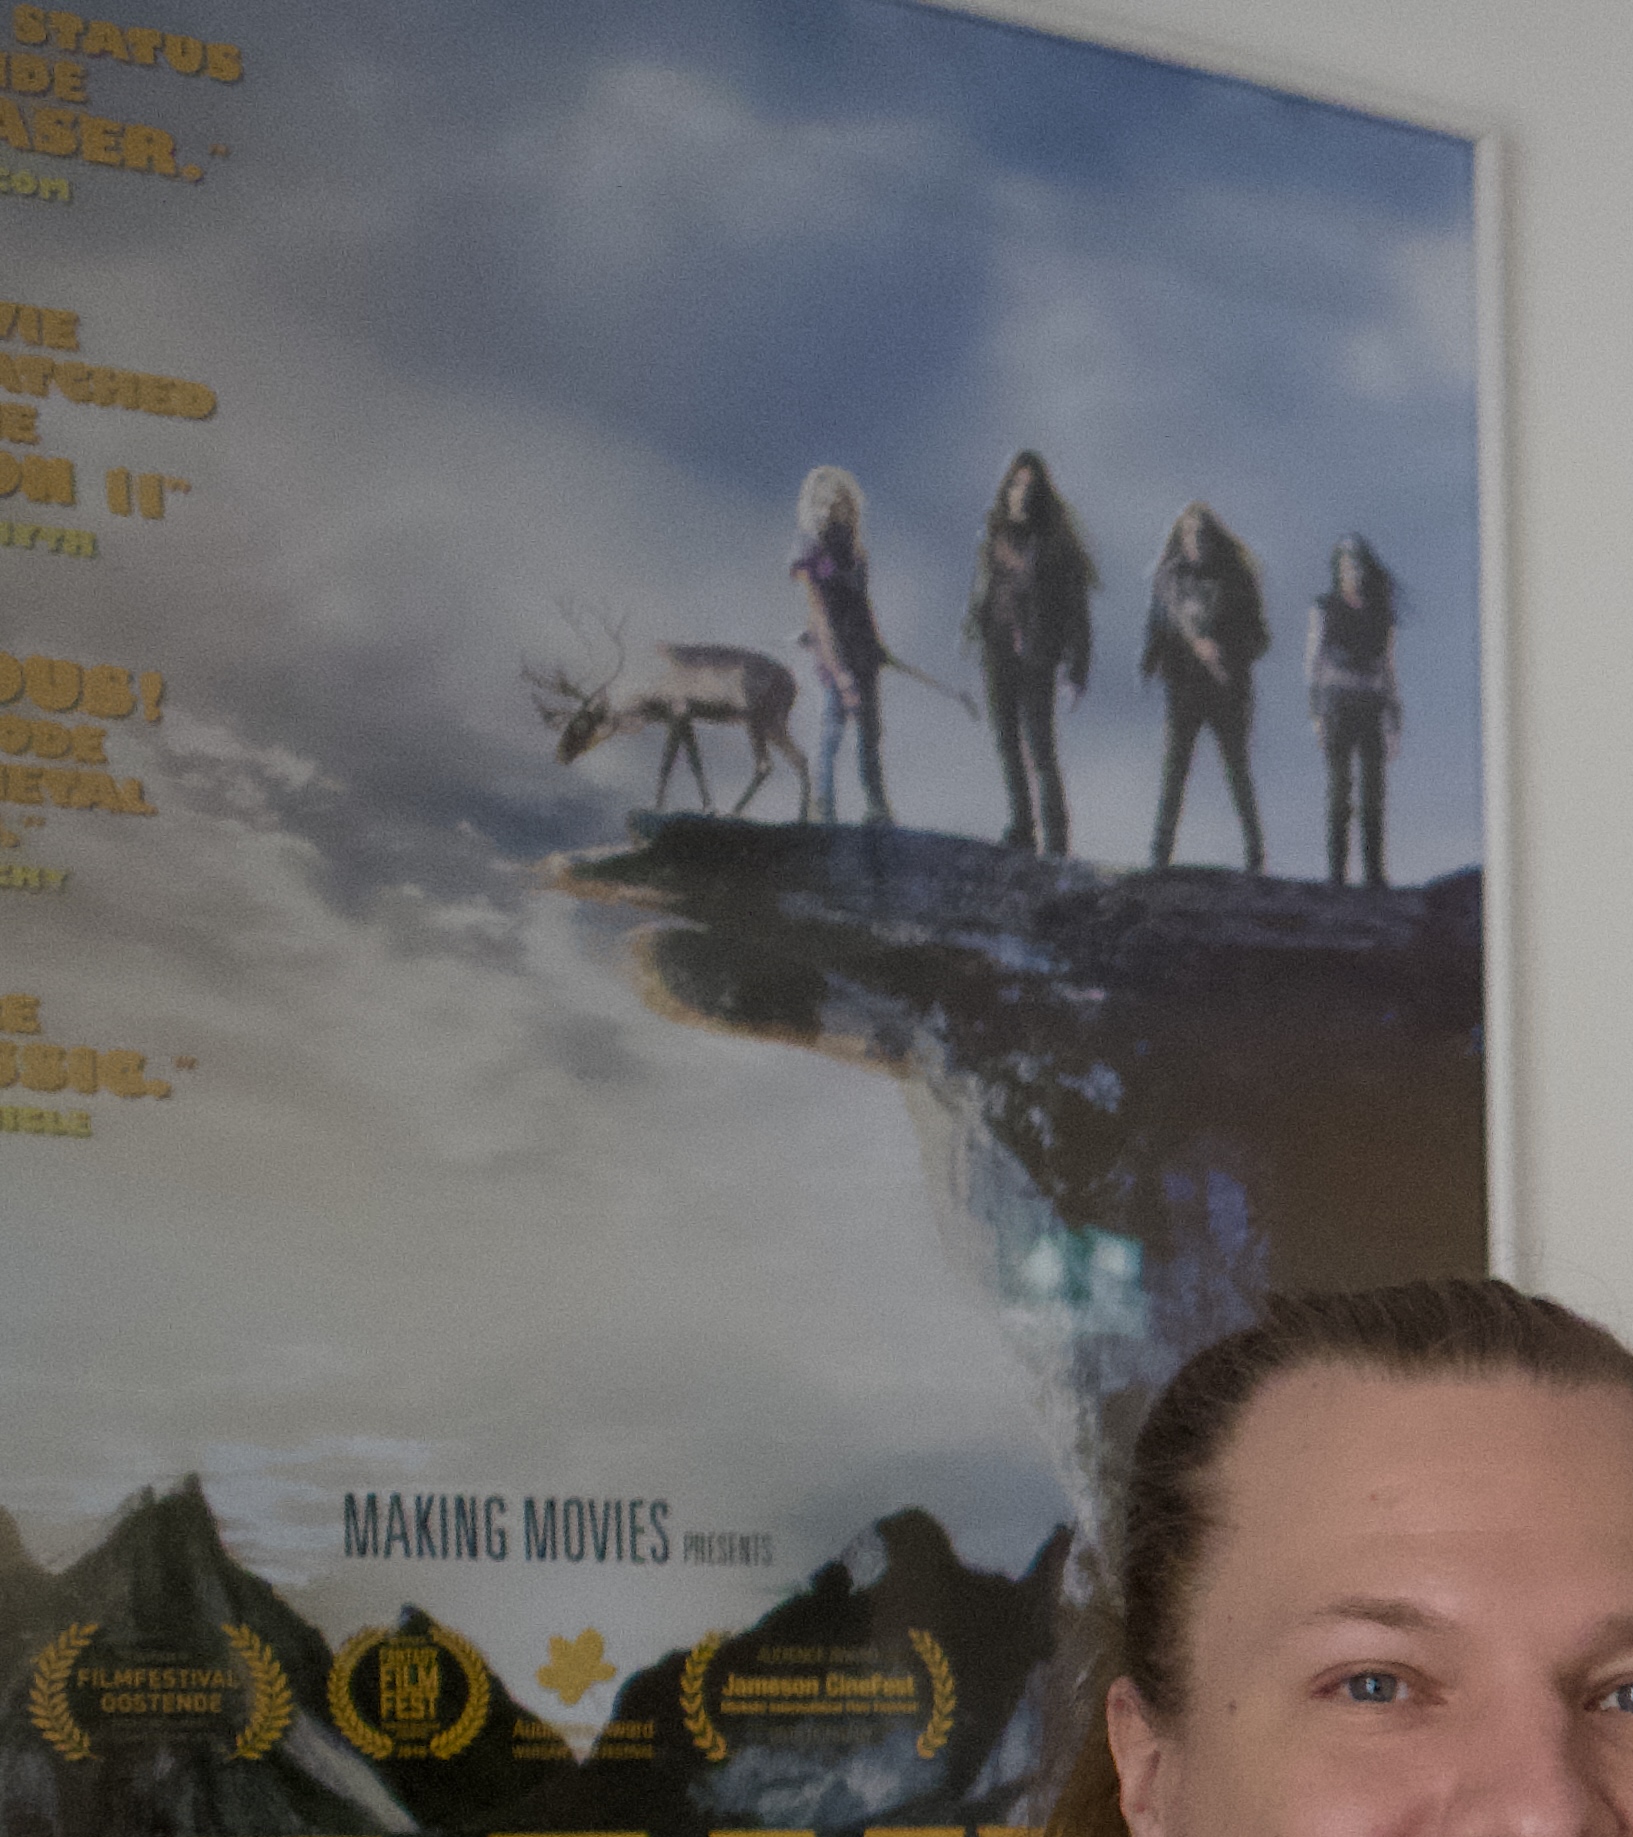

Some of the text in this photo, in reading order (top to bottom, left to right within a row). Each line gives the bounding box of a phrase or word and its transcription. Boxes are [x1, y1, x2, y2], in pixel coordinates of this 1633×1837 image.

[12, 3, 239, 82] STATUS
[343, 1491, 774, 1568] MAKING MOVIES PRESENTS
[76, 1667, 237, 1689] FILMFESTIVAL
[720, 1672, 915, 1697] Jameson CineFest
[100, 1692, 222, 1713] OOSTENDE
